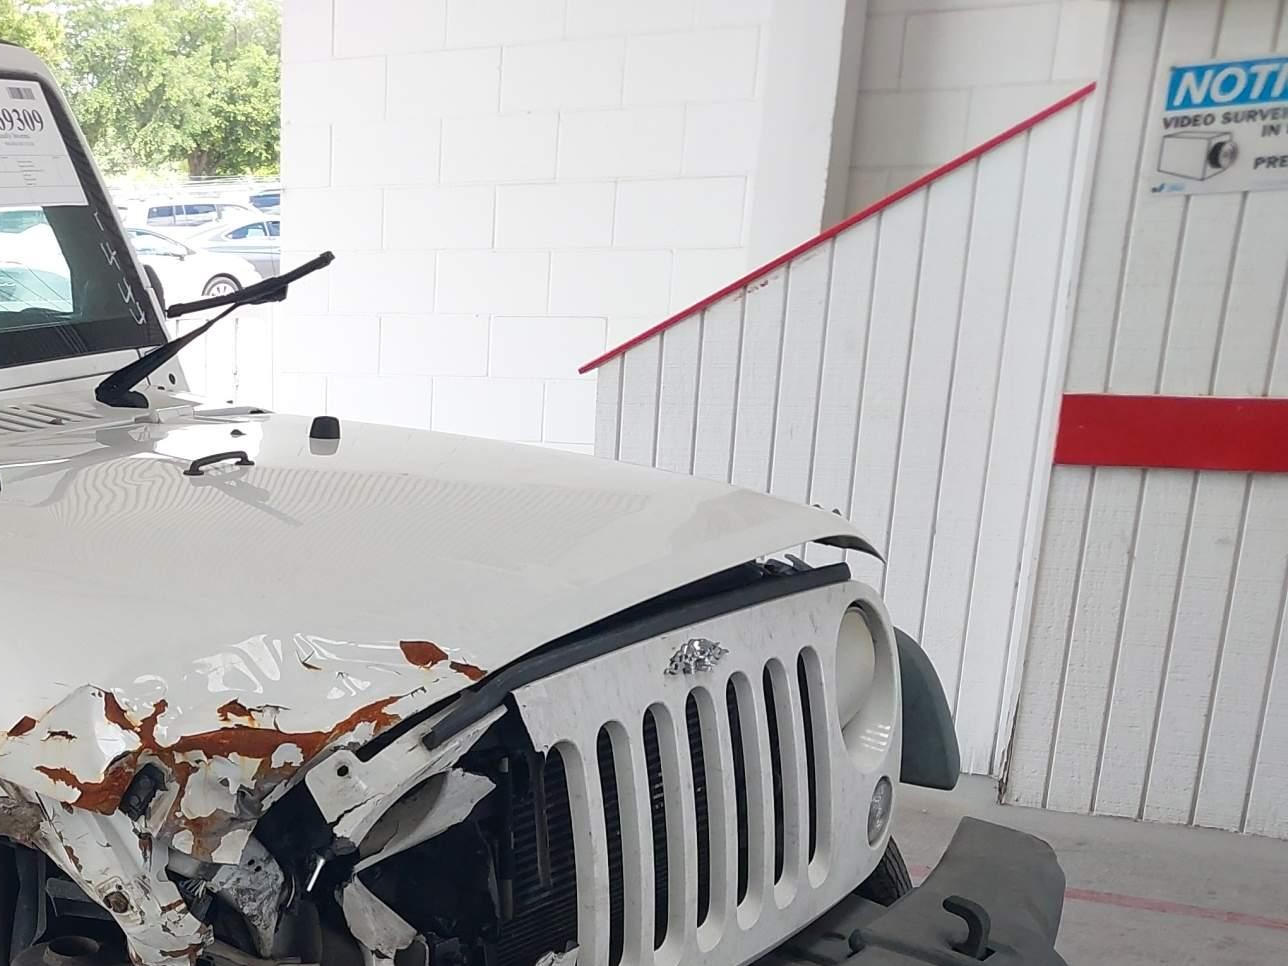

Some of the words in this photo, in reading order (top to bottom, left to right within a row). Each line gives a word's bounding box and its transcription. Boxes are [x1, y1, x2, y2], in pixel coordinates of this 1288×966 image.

[1162, 114, 1216, 130] VIDEO
[1261, 124, 1281, 137] IN
[1253, 154, 1288, 170] PRE
